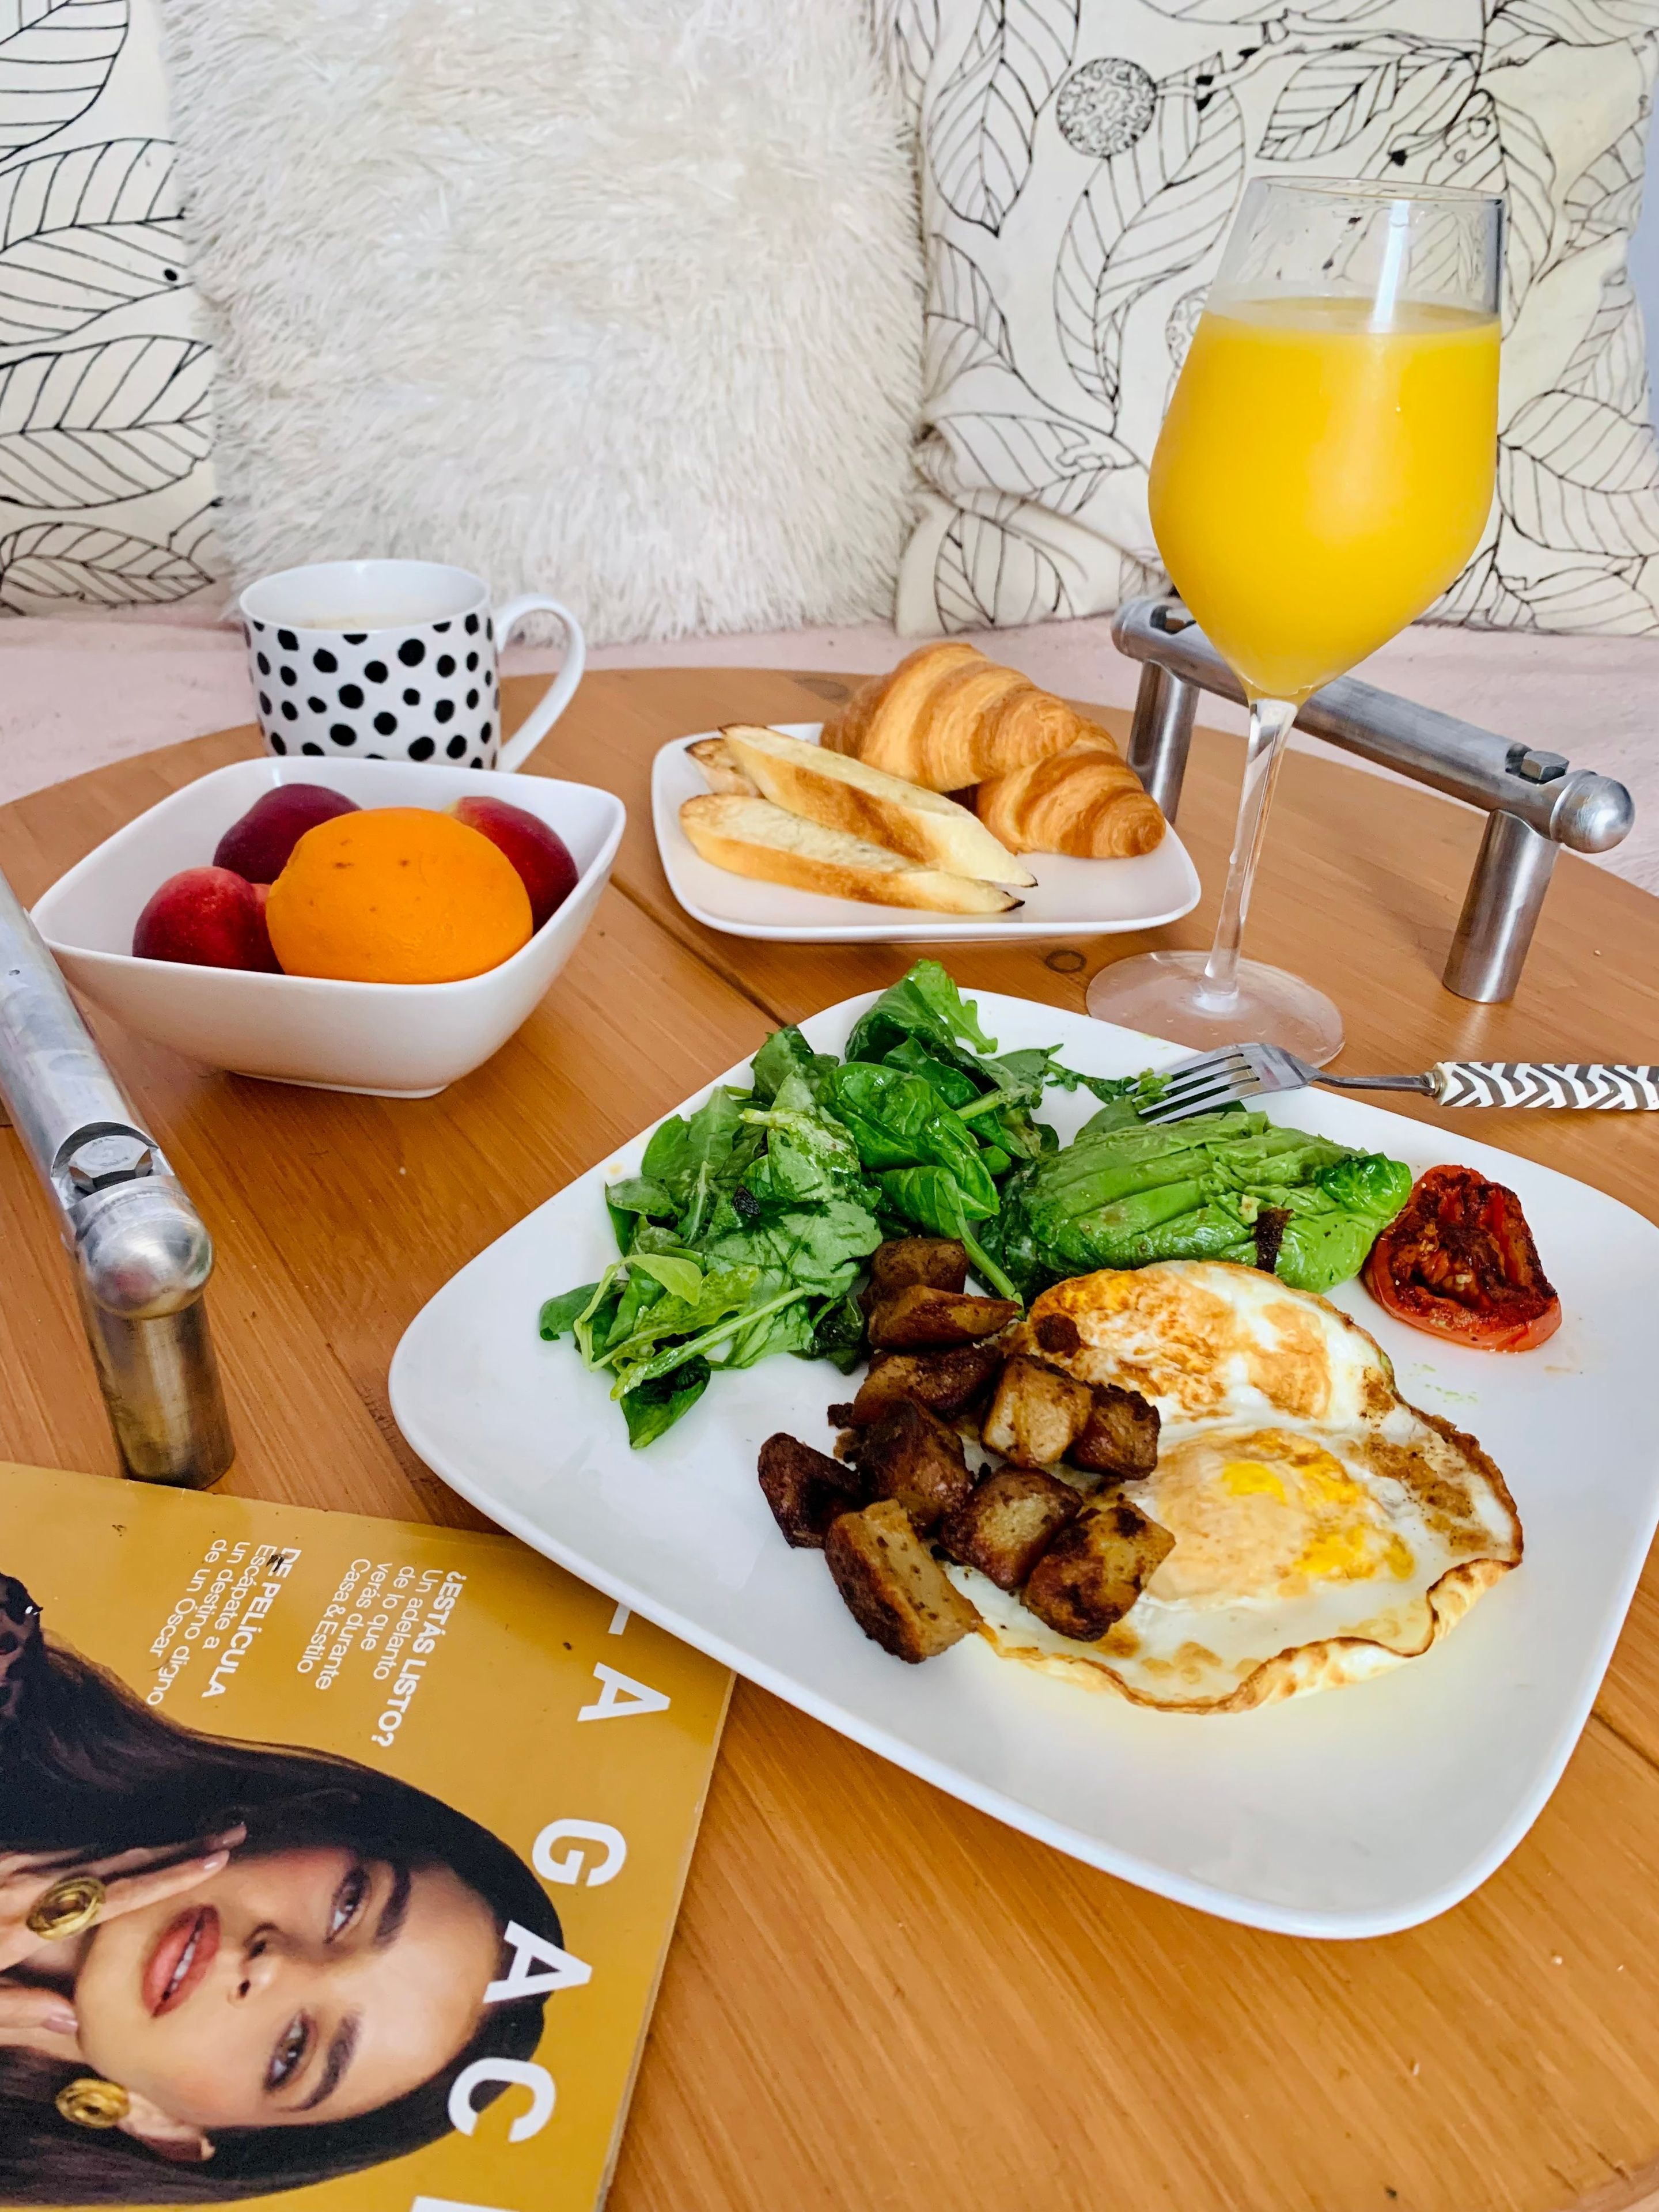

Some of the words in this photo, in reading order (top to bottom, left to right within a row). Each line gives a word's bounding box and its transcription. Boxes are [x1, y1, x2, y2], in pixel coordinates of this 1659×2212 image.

[204, 1539, 228, 1563] de
[226, 1541, 251, 1563] un
[267, 1547, 302, 1578] DE
[186, 1569, 211, 1592] un
[214, 1544, 278, 1630] Escápate
[355, 1563, 393, 1609] verás
[393, 1566, 416, 1589] de
[415, 1569, 444, 1593] Un
[184, 1569, 233, 1640] destino
[382, 1593, 406, 1609] lo
[412, 1571, 467, 1654] ¿ESTÁS
[149, 1597, 199, 1658] Óscar
[202, 1636, 220, 1649] a
[360, 1613, 389, 1651] que
[373, 1597, 423, 1680] adelanto
[315, 1613, 365, 1690] durante
[146, 1645, 190, 1705] digno
[371, 1658, 427, 1747] LISTO?
[410, 1818, 628, 2212] GAC
